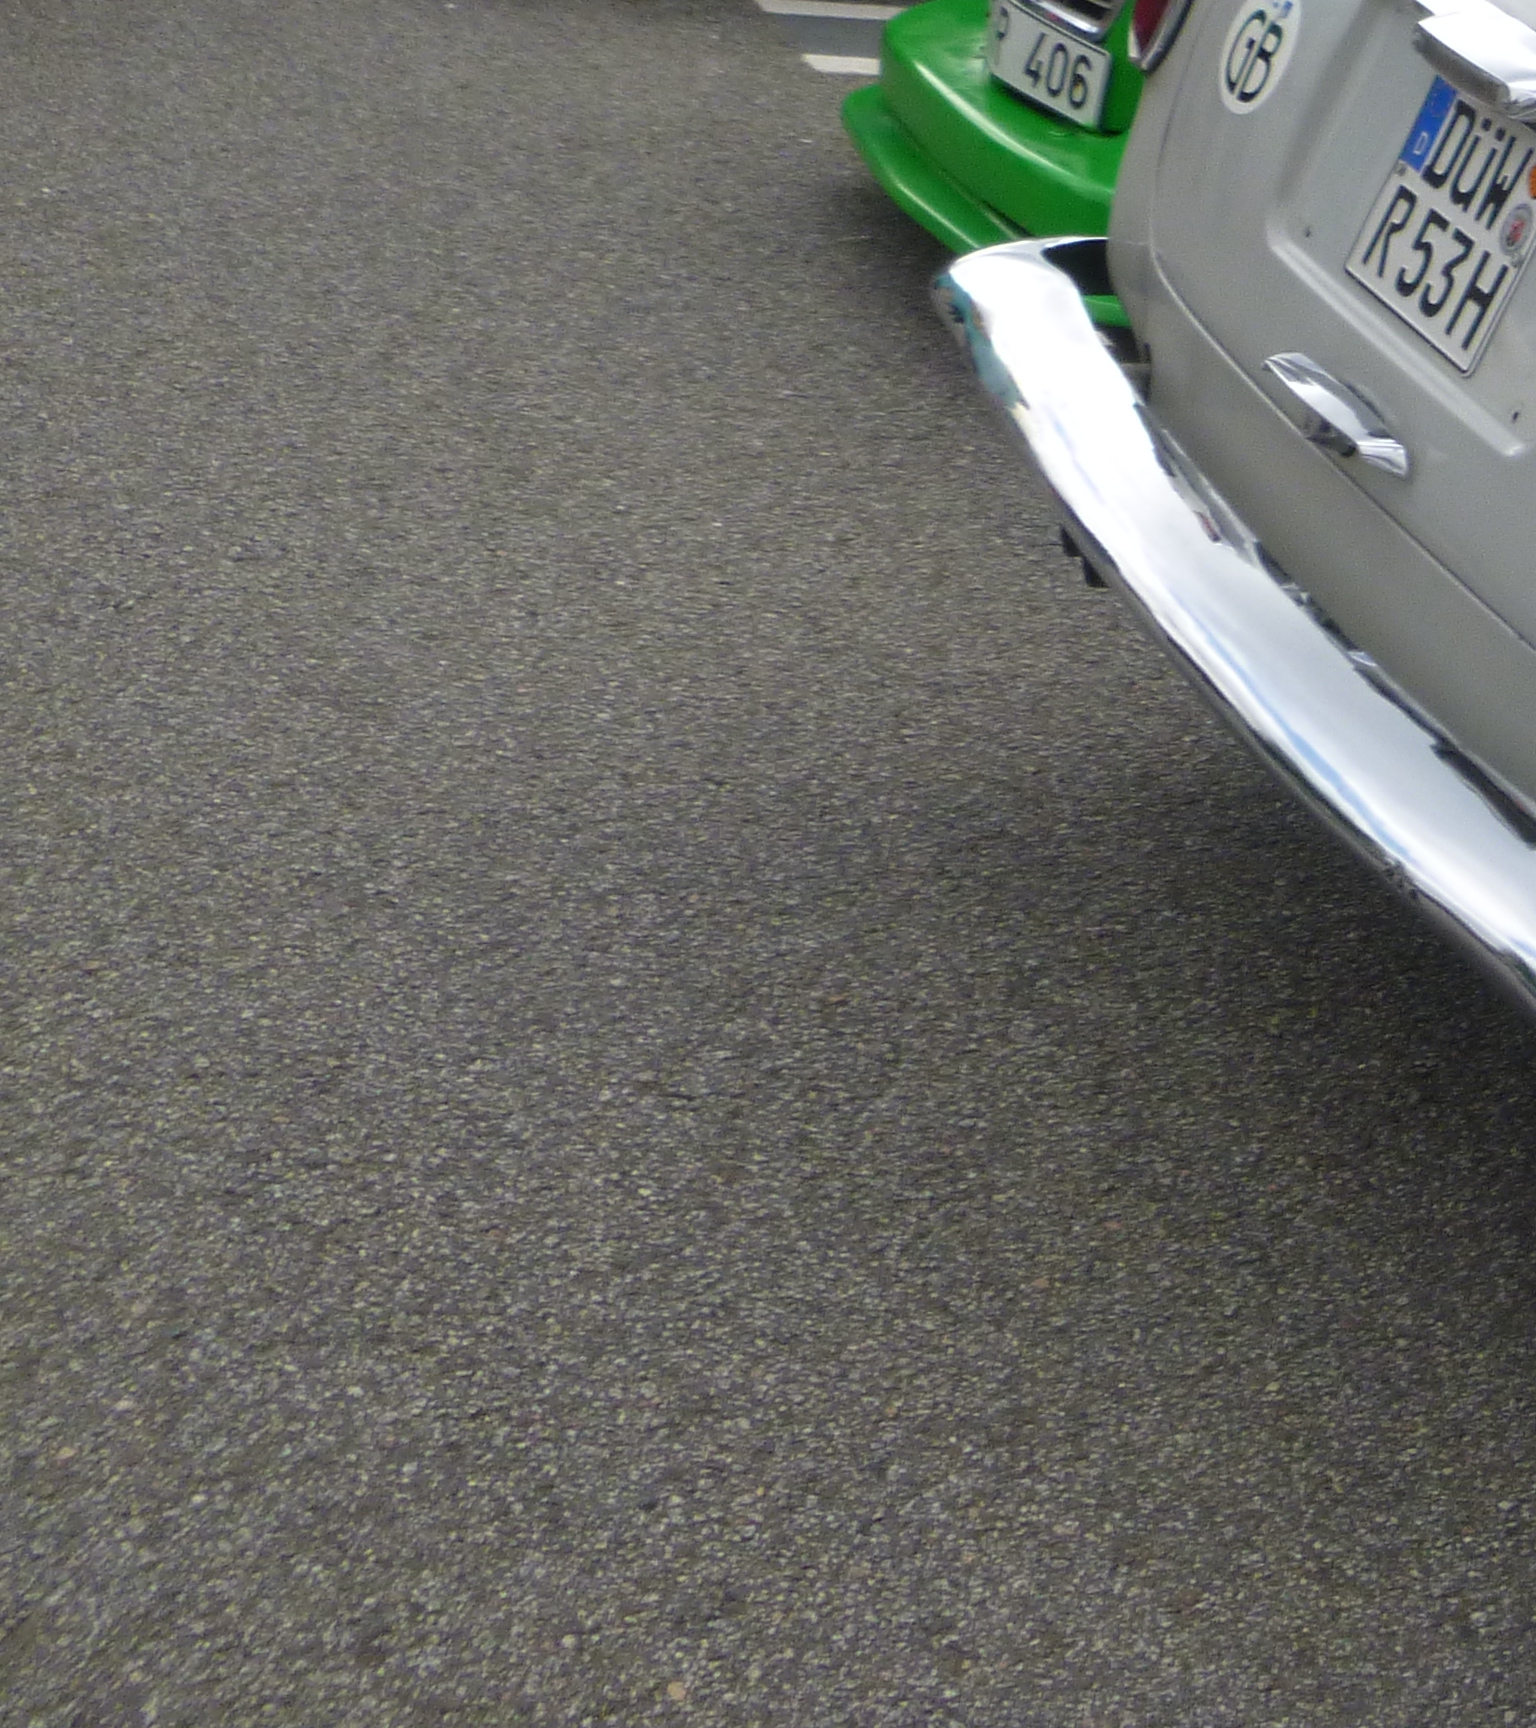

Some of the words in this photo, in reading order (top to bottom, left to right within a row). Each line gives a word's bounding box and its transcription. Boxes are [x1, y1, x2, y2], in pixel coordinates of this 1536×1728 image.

[1023, 33, 1093, 110] 406
[1226, 9, 1283, 103] GB
[1413, 131, 1429, 156] D
[1422, 99, 1534, 230] DÜW
[1362, 183, 1510, 351] R53H
